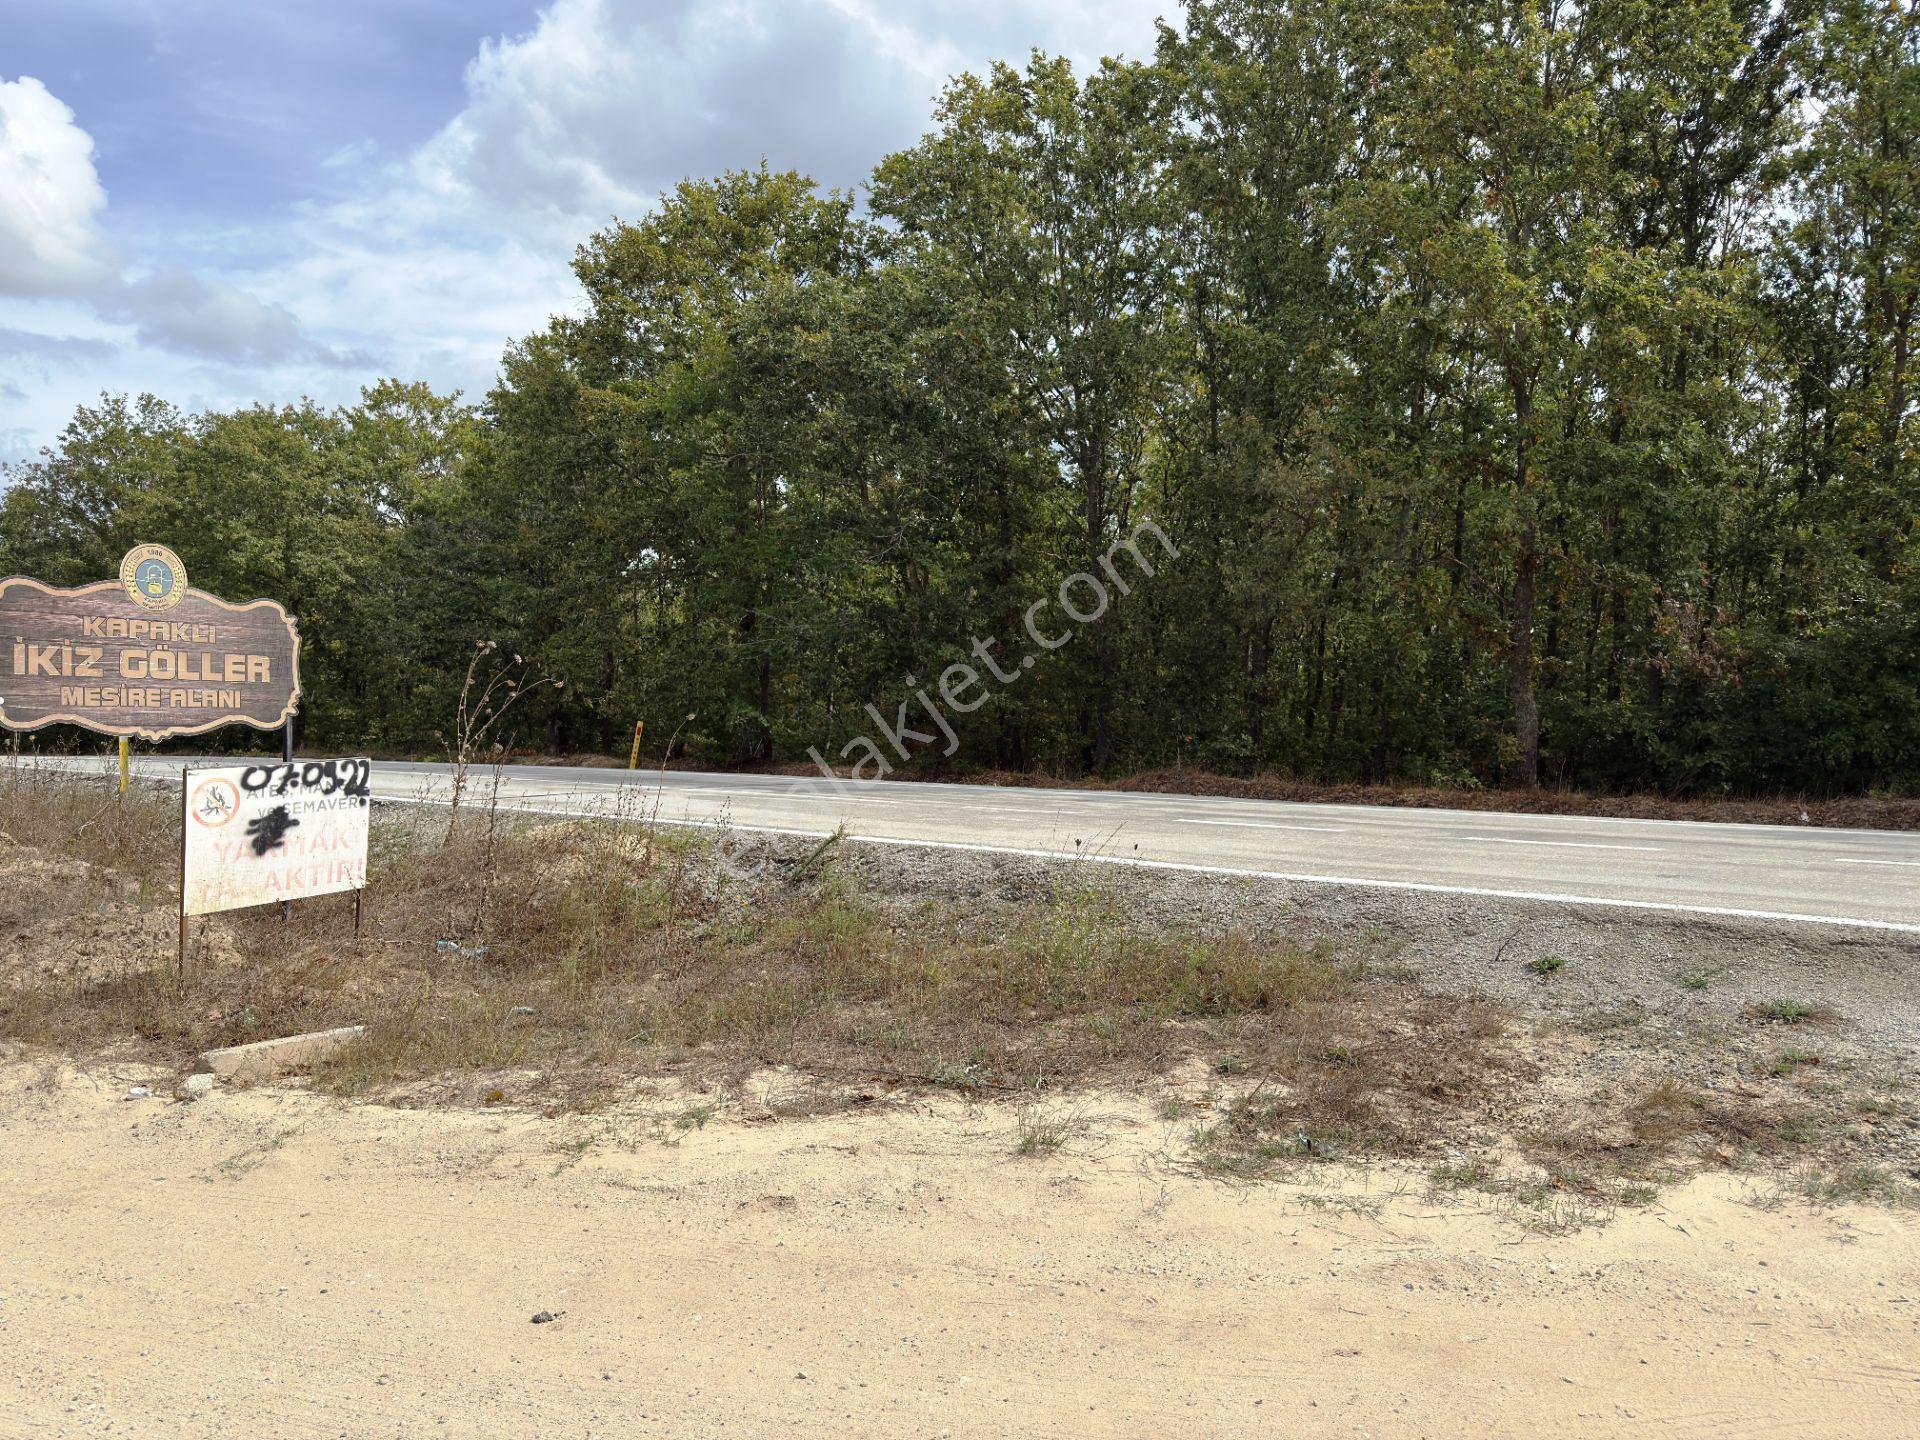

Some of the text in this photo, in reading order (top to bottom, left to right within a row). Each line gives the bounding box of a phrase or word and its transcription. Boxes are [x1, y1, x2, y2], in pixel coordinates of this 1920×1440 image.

[83, 616, 216, 644] KAPAKLI
[13, 636, 271, 683] İKİZ GÖLLER
[60, 684, 241, 709] MESİRE ALANI
[283, 796, 358, 816] SEMAVER
[213, 828, 350, 864] YAMAK
